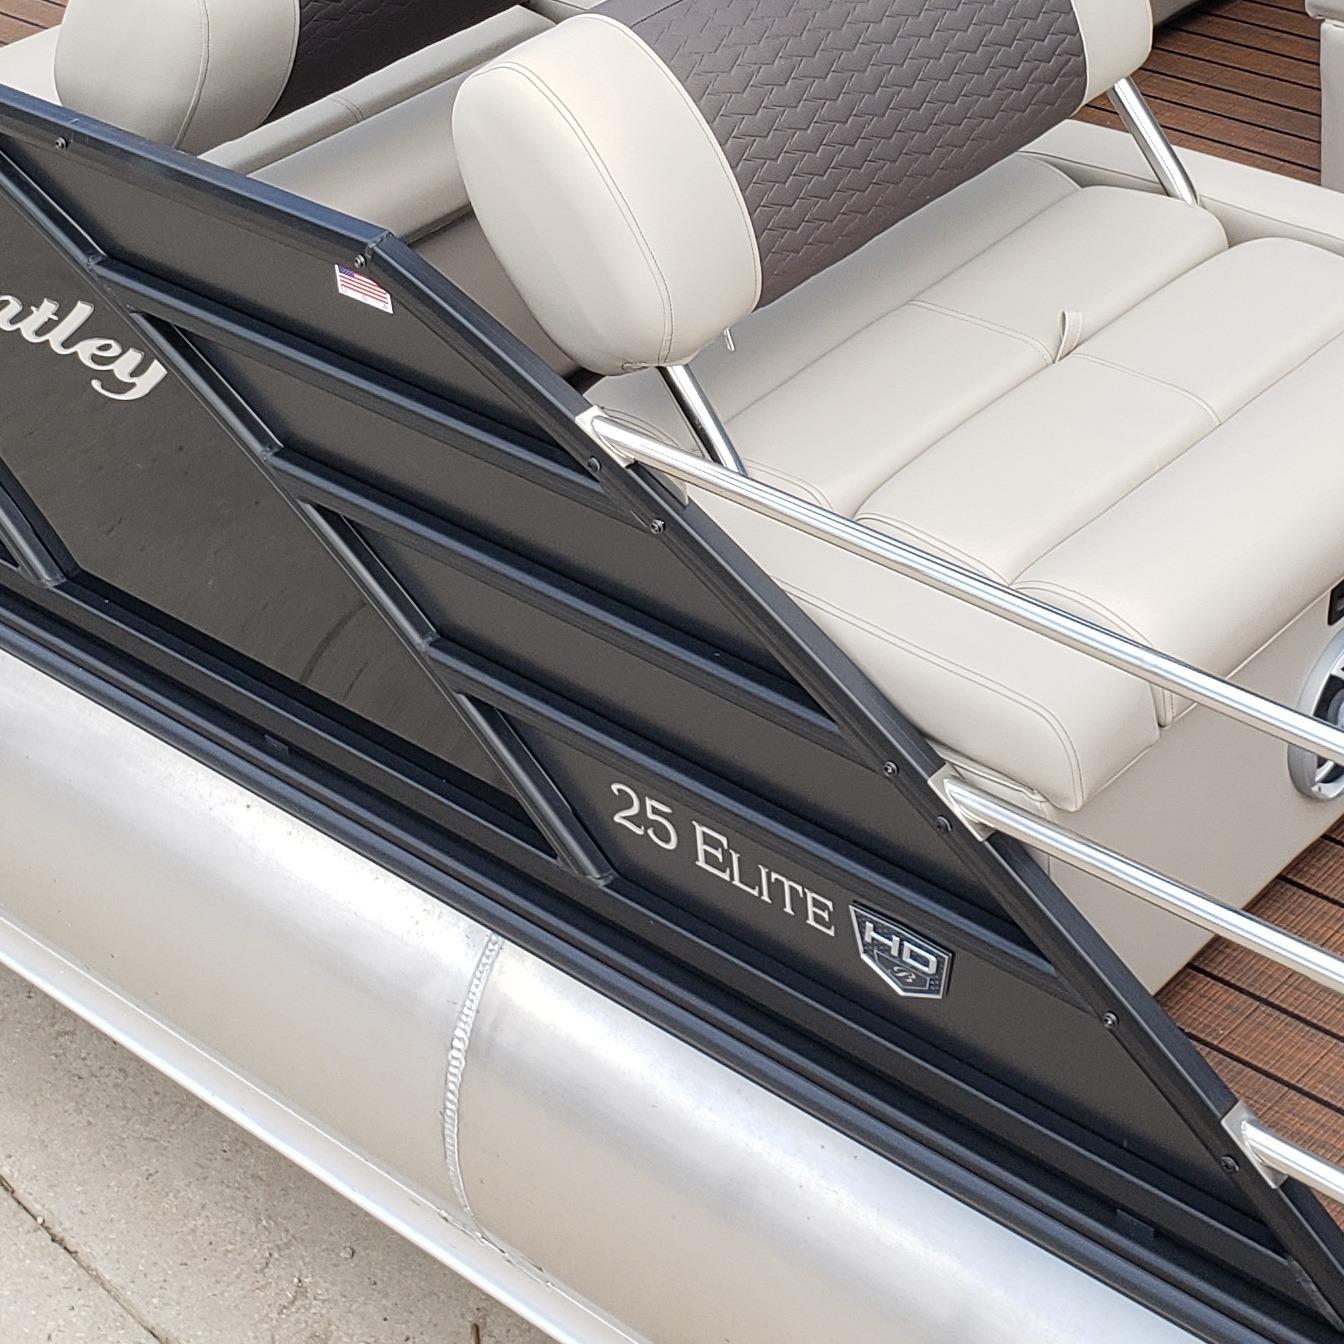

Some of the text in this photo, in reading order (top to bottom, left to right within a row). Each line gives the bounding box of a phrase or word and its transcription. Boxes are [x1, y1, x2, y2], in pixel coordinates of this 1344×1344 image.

[610, 782, 836, 937] 25 ELITE
[864, 920, 938, 975] HD
